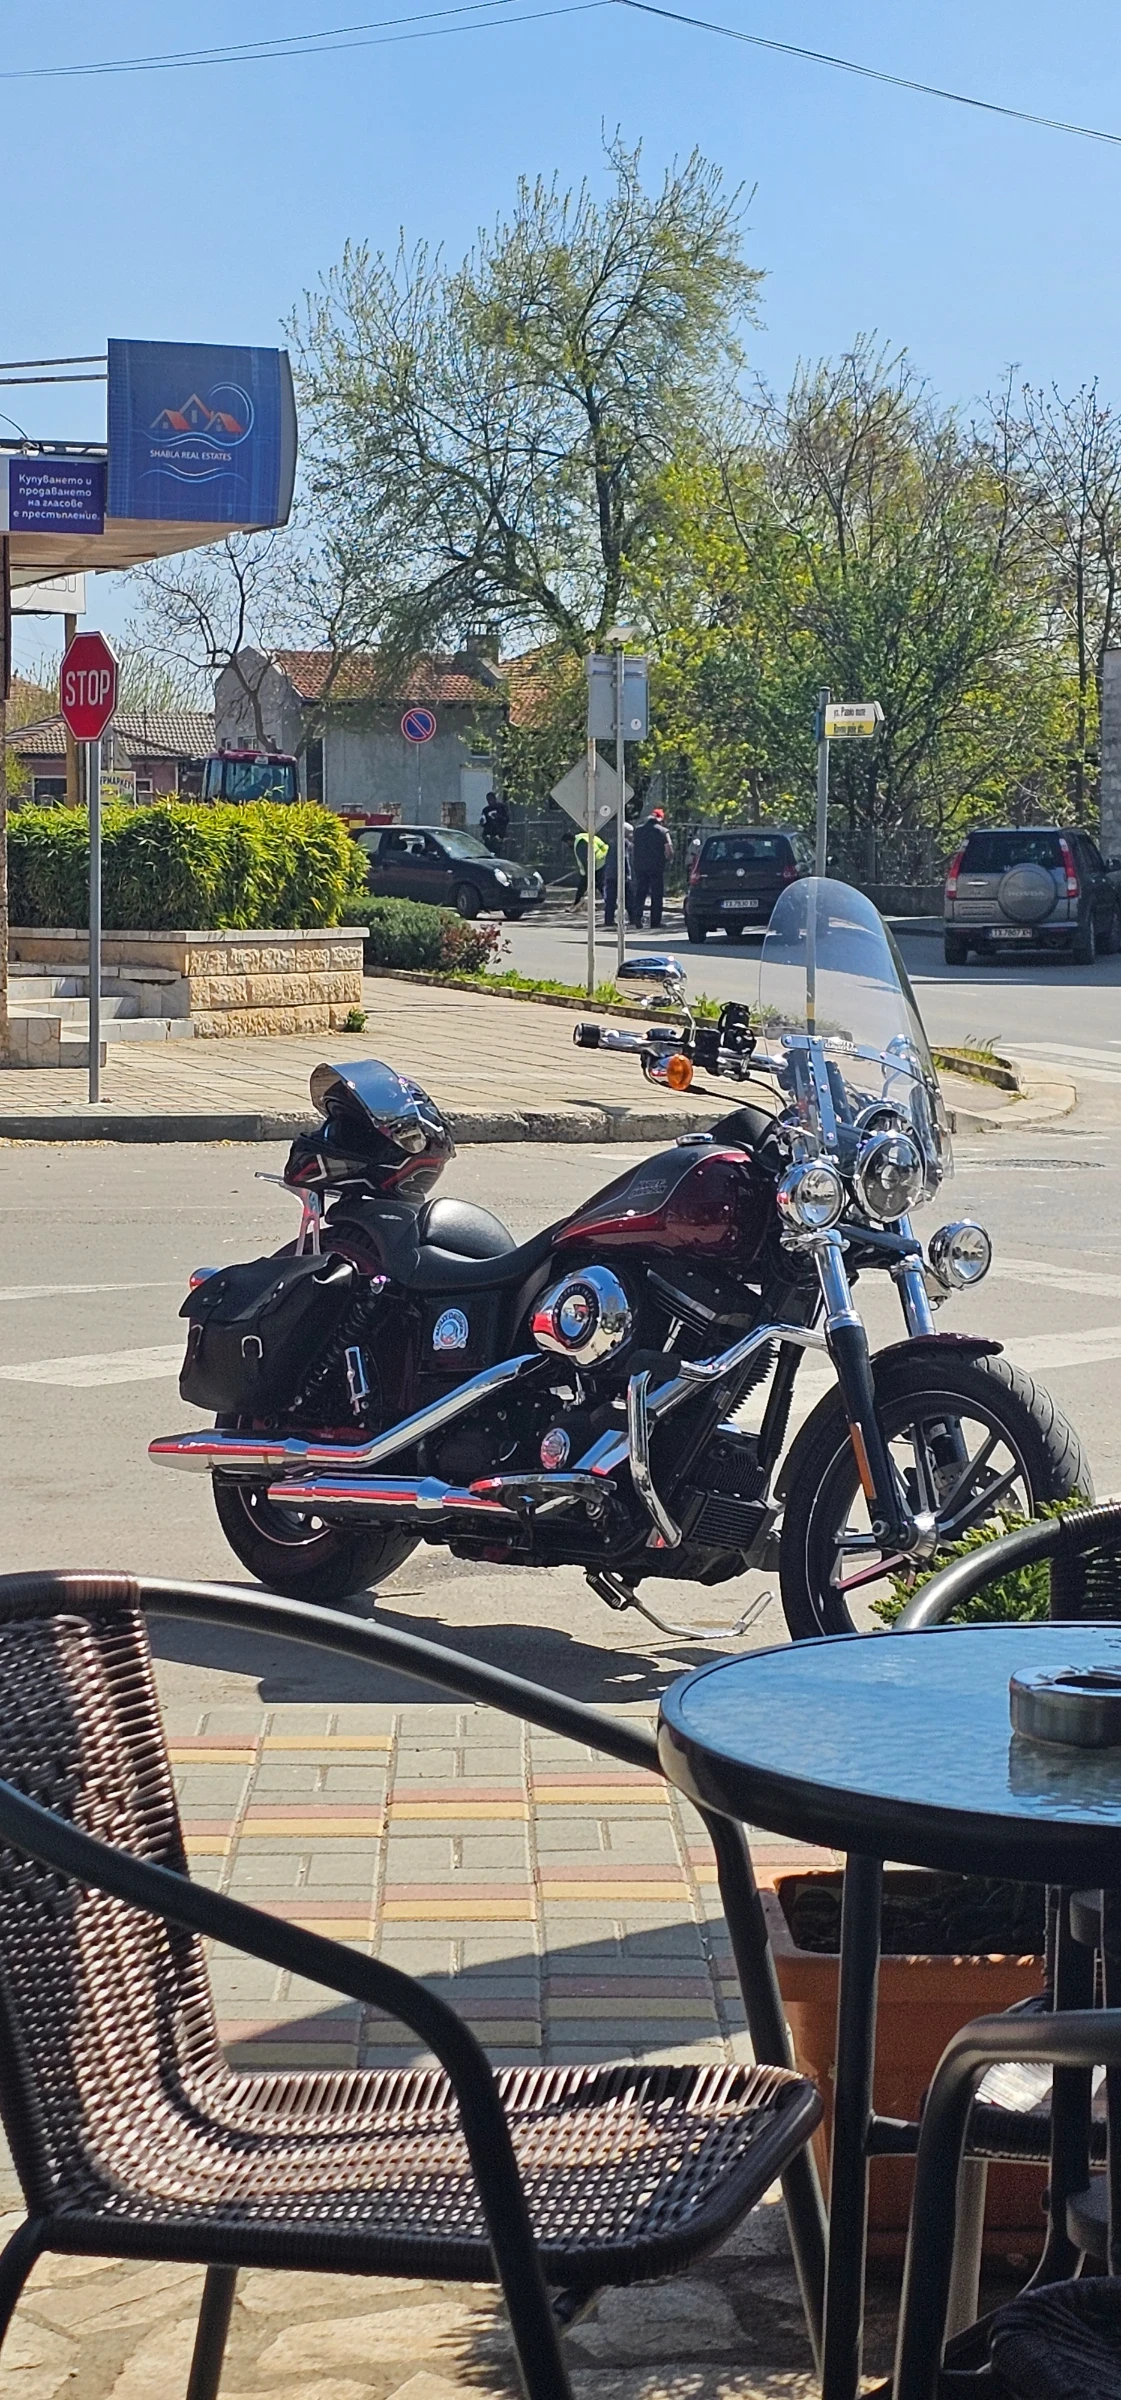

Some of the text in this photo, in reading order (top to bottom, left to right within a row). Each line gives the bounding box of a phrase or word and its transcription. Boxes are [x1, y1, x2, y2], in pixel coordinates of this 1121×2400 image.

[150, 449, 232, 461] SHABLA REAL ESTATES
[19, 474, 83, 486] Купуването
[19, 487, 92, 498] продаването
[28, 499, 83, 508] на гласове
[13, 510, 100, 520] е престъпление.
[65, 669, 111, 707] STOP
[1008, 890, 1045, 898] HONDA
